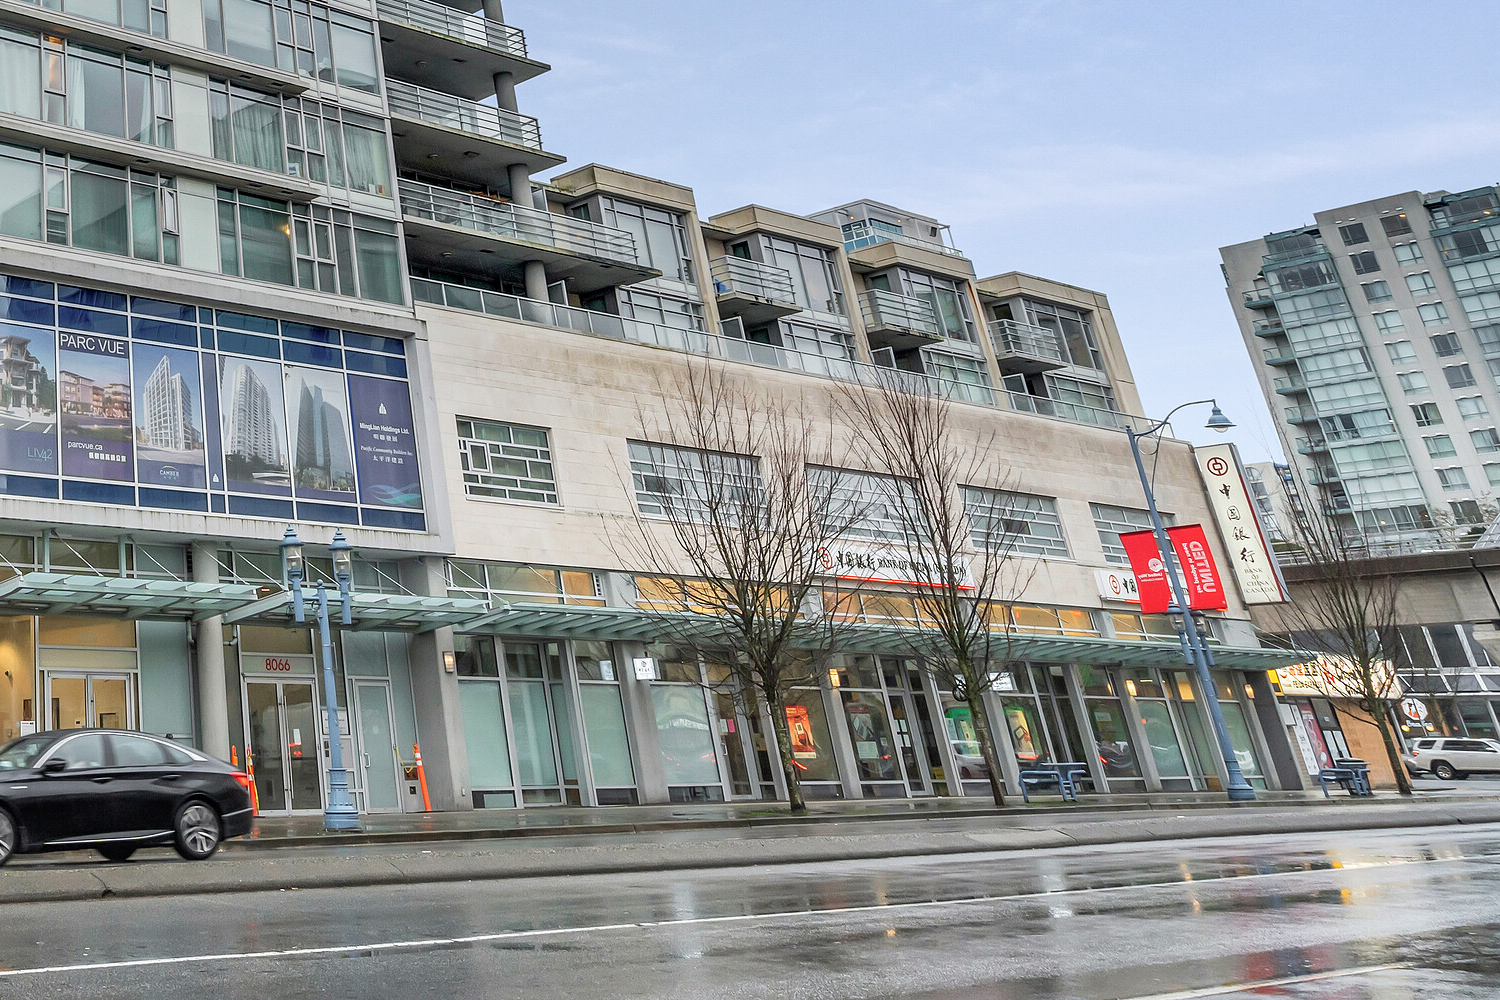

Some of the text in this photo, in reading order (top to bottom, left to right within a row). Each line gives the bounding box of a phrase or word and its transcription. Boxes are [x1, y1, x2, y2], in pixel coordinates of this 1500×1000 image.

[60, 334, 125, 355] PARC VUE
[360, 422, 380, 431] MingLian
[381, 425, 400, 434] Holdings
[67, 441, 103, 451] parcvue.ca
[159, 469, 180, 478] CAMBER
[265, 658, 291, 671] 8066
